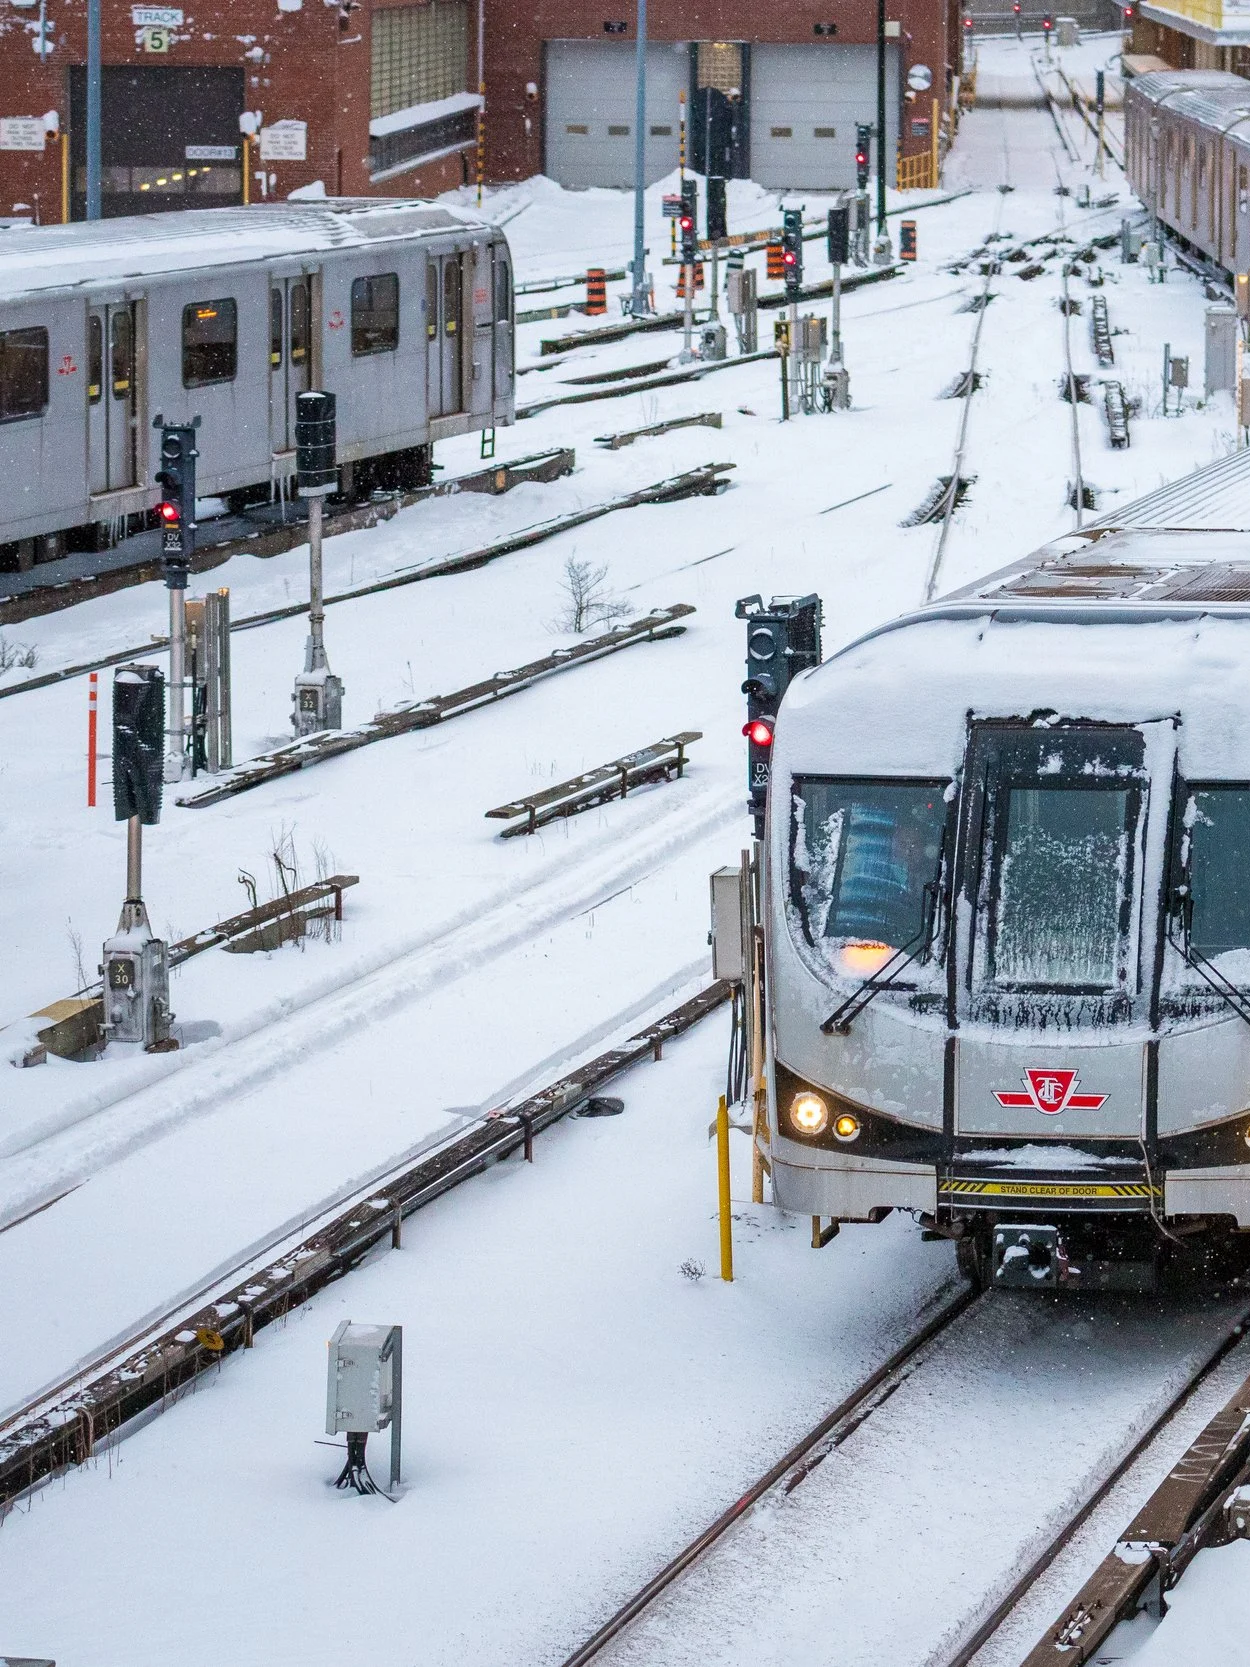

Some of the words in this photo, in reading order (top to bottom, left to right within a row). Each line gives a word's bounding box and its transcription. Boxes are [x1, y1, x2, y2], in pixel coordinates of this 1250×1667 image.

[137, 11, 179, 22] TRACK
[151, 32, 163, 49] 5
[167, 533, 179, 541] DV
[165, 541, 181, 549] X32
[305, 692, 312, 700] X
[303, 700, 314, 708] 32
[117, 963, 125, 973] X
[115, 975, 129, 984] 30
[1000, 1185, 1028, 1194] STAND
[1029, 1186, 1057, 1195] CLEAR
[1058, 1187, 1071, 1195] OF
[1072, 1187, 1098, 1196] DOOR
